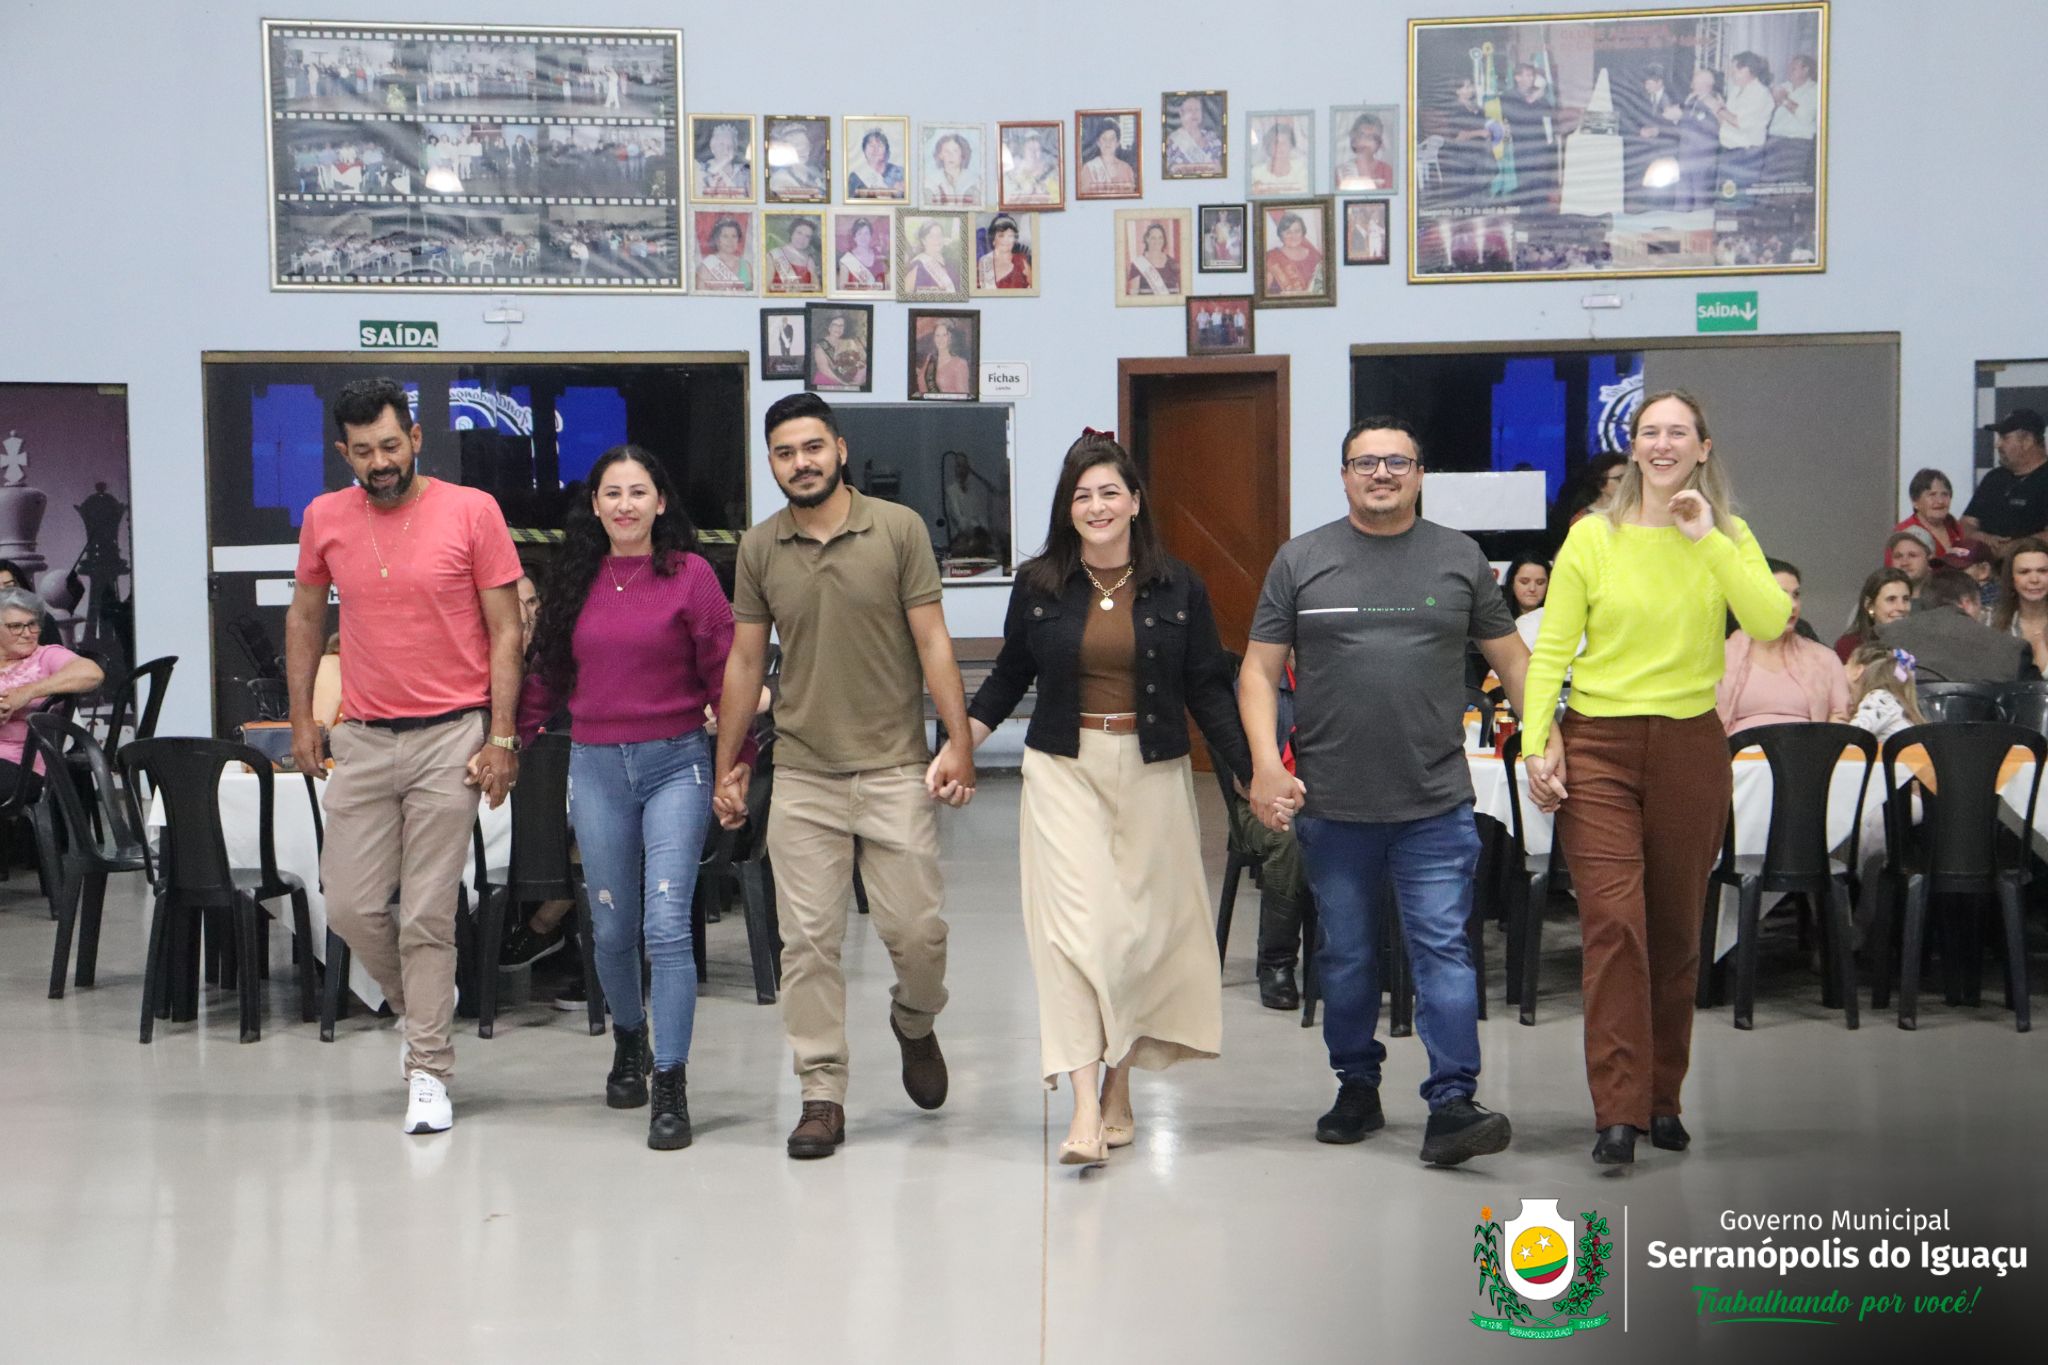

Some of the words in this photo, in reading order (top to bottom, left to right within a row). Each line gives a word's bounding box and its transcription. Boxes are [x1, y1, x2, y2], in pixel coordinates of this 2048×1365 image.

[1698, 302, 1740, 318] SAÍDA
[361, 323, 438, 346] SAÍDA
[988, 372, 1020, 383] Fichas
